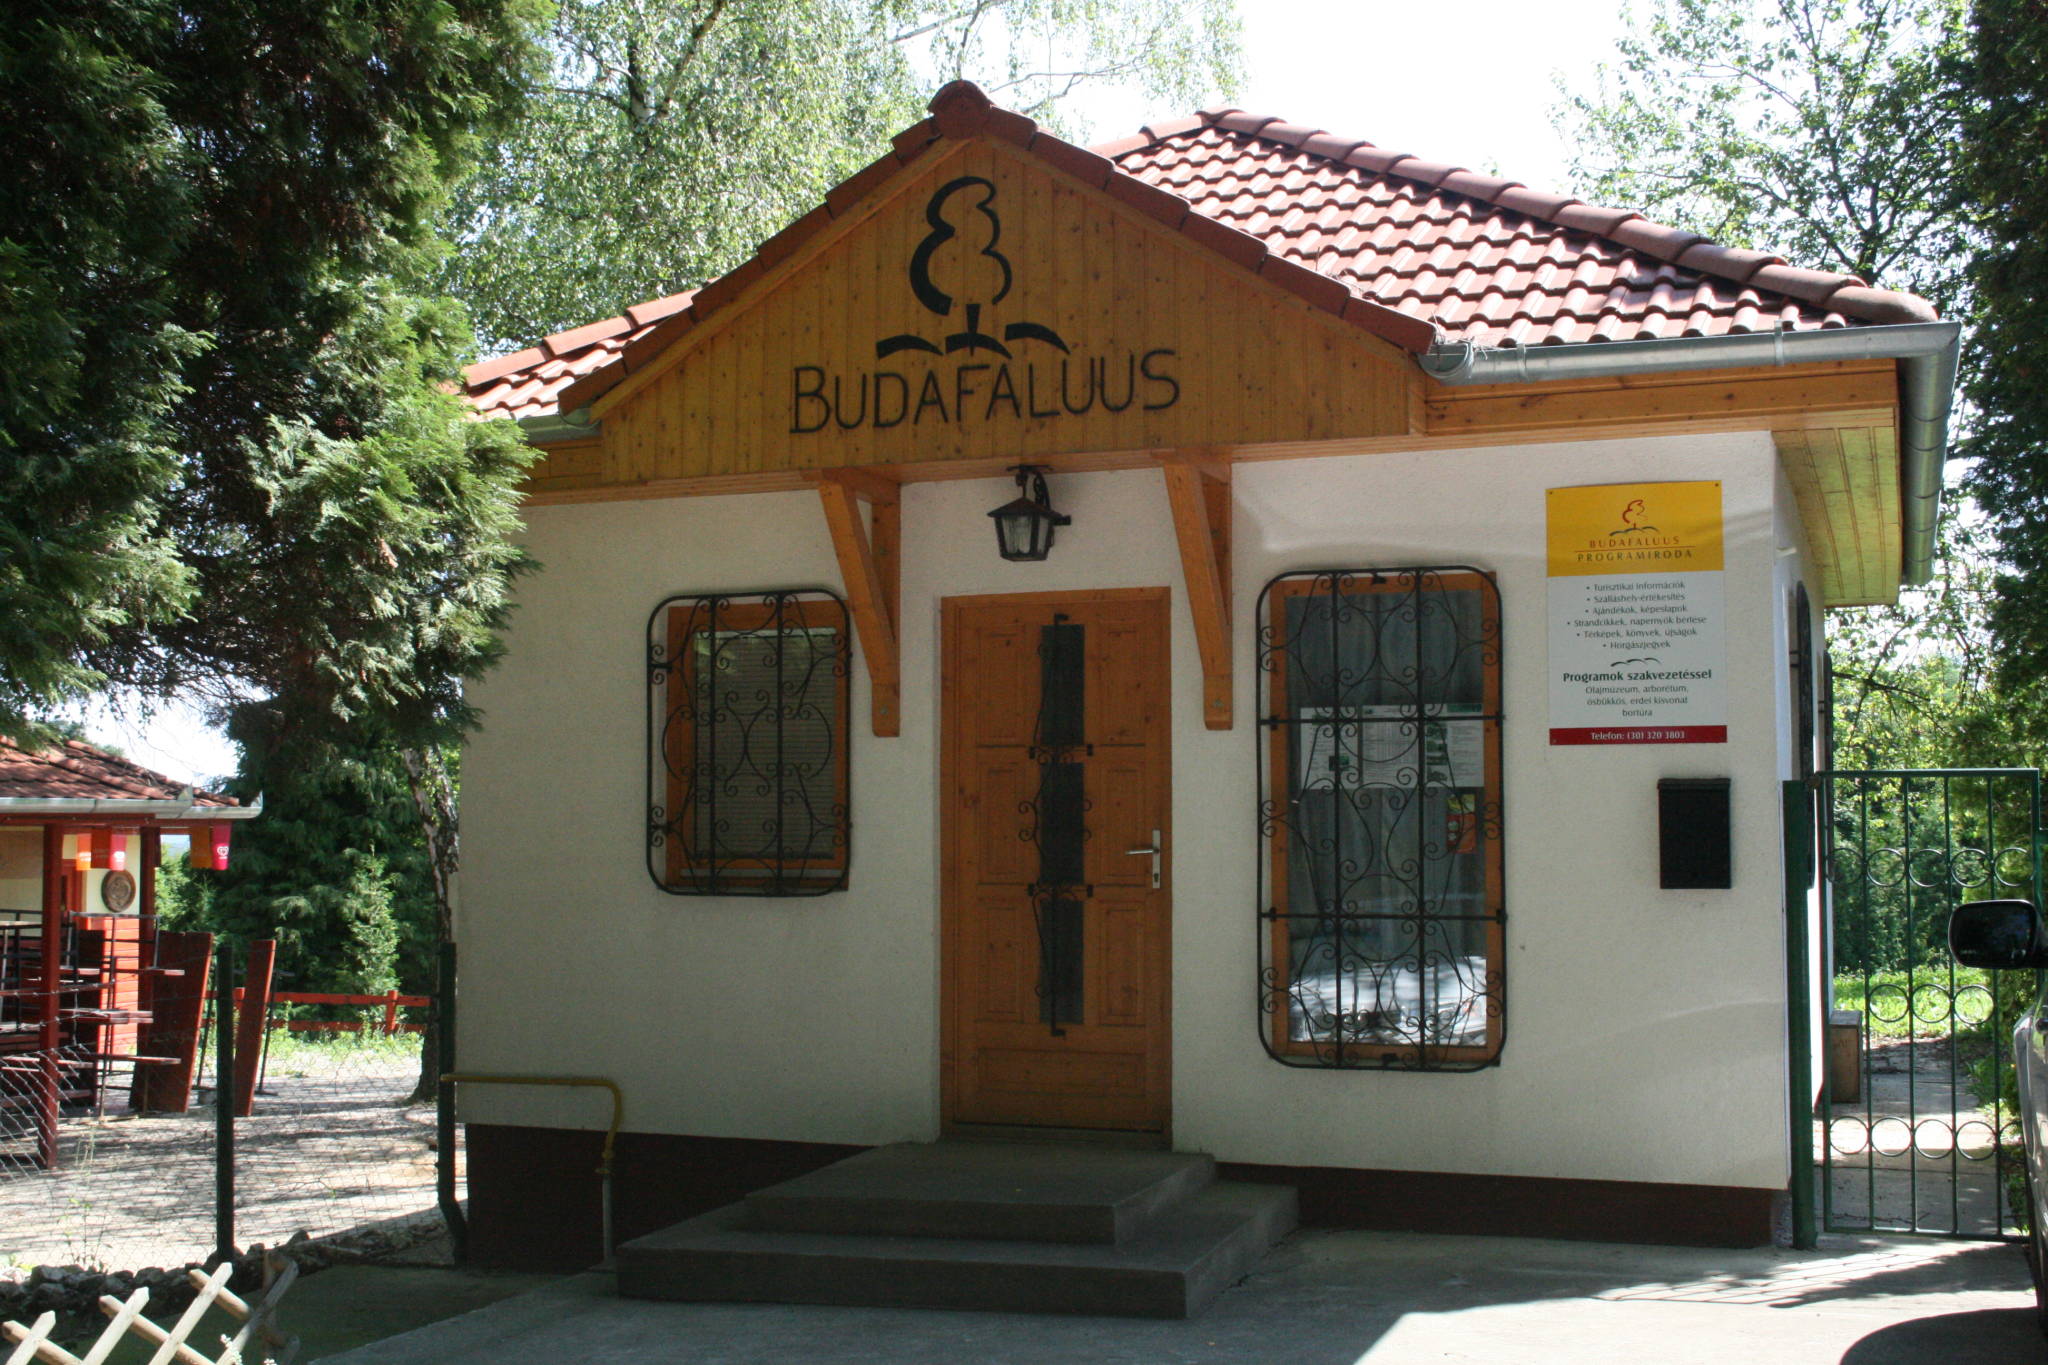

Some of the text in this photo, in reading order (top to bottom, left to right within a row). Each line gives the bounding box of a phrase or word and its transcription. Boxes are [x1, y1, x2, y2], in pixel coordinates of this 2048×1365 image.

[789, 348, 1180, 434] BUDAFALUUS
[1589, 536, 1680, 549] BUDAFALUUS
[1577, 549, 1693, 562] PROGRAMIRODA
[1594, 583, 1633, 592] Turisztikai
[1563, 669, 1712, 684] Programok szakvezetéssel
[1630, 697, 1652, 705] erdei
[1591, 732, 1624, 740] Telefon:
